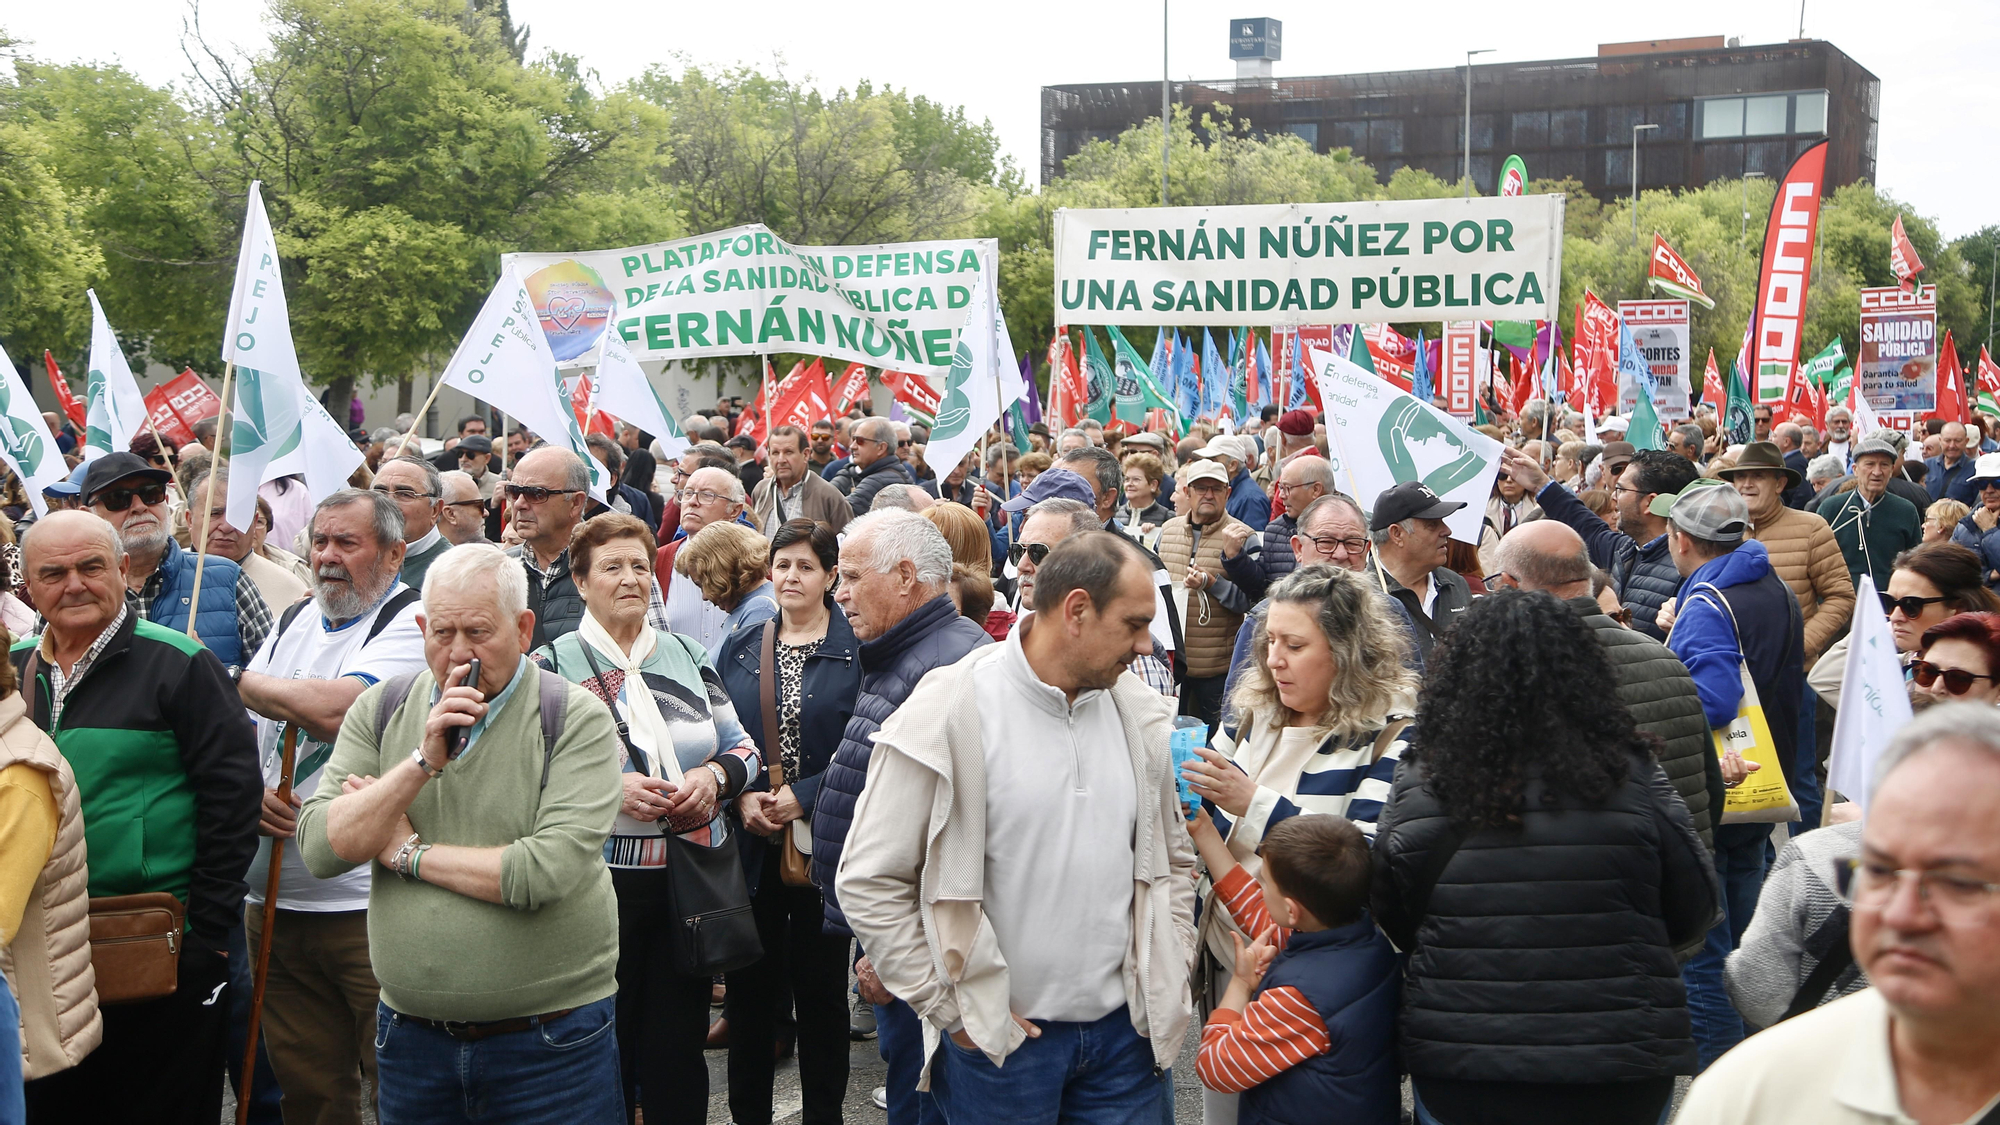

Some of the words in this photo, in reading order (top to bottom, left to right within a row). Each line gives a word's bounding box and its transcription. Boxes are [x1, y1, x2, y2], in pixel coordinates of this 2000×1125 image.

[1088, 219, 1245, 261] FERNÁN
[1259, 215, 1410, 259] NÚÑEZ
[1423, 219, 1515, 253] POR
[832, 249, 981, 279] DEFENSA
[1655, 245, 1699, 292] CCOO
[1759, 182, 1814, 360] CCOO
[703, 265, 828, 293] SANIDAD
[947, 285, 976, 309] D
[1061, 279, 1143, 310] UNA
[1151, 278, 1339, 311] SANIDAD
[1352, 267, 1545, 310] PÚBLICA
[1619, 304, 1687, 320] CCOO
[617, 295, 826, 350] FERNÁN
[832, 314, 963, 366] NÚÑE
[1863, 320, 1933, 343] SANIDAD
[1641, 347, 1681, 360] CORTES
[1878, 340, 1926, 358] PÚBLICA
[1324, 362, 1340, 380] En
[1342, 374, 1378, 394] defensa
[1452, 336, 1470, 409] CCOO
[1656, 376, 1672, 387] TAN
[1863, 382, 1883, 391] para
[1885, 381, 1894, 389] tu
[1896, 379, 1918, 388] salud
[904, 375, 942, 414] CCO
[1328, 391, 1358, 408] anidad
